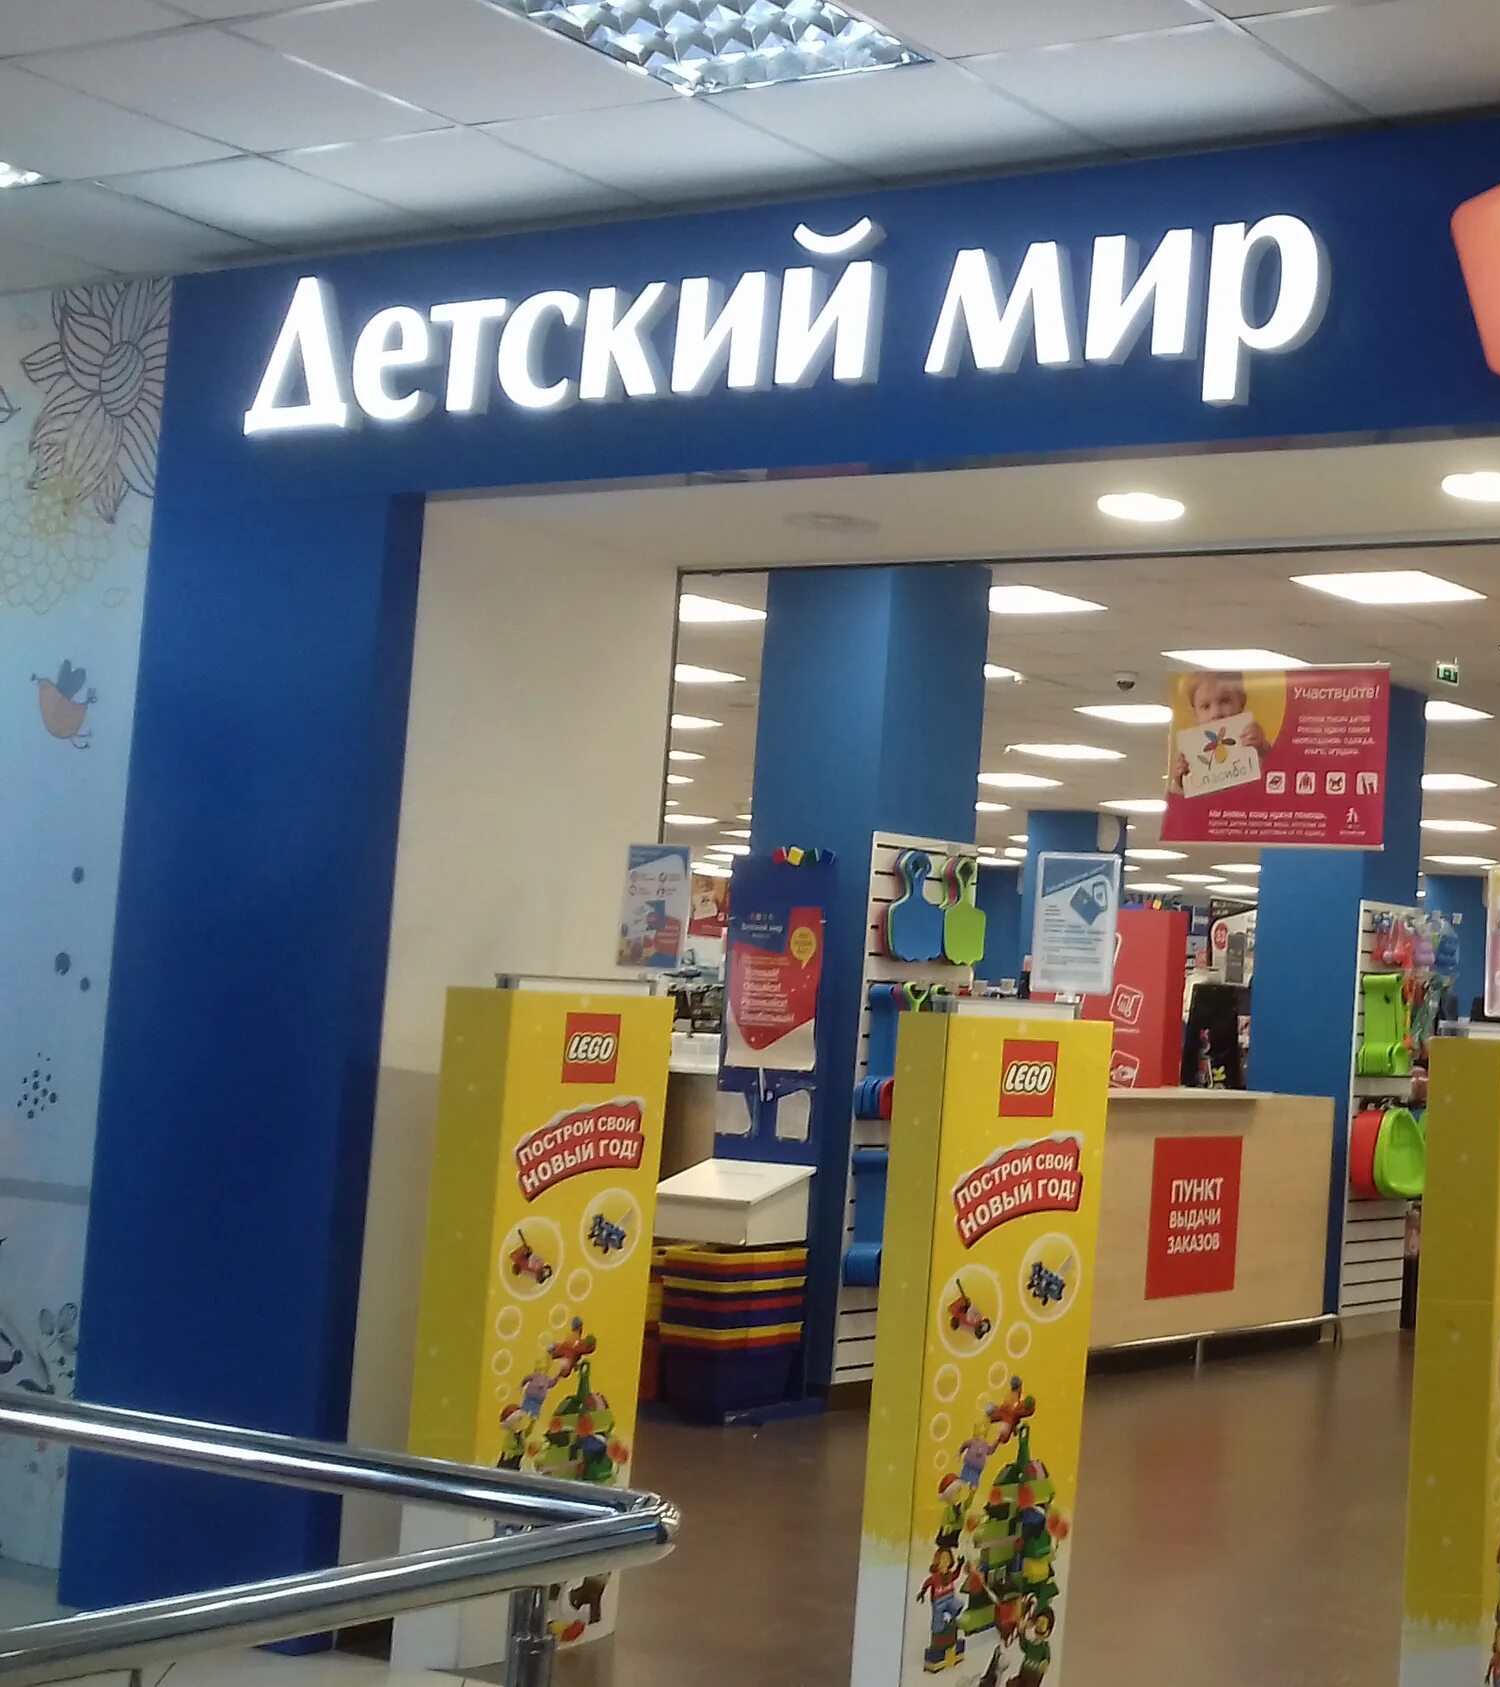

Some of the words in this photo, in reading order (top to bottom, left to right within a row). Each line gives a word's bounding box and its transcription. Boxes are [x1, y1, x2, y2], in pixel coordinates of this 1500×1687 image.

[244, 214, 882, 436] Детский
[924, 212, 1328, 404] мир
[1293, 685, 1380, 702] Участвуйте!
[567, 1033, 616, 1062] LEGO
[1003, 1062, 1054, 1094] LEGO
[518, 1116, 595, 1167] ПОСТРОЙ
[522, 1139, 595, 1194] НОВЫЙ
[599, 1139, 639, 1161] ГОД!
[956, 1152, 1033, 1209] ПОСТРОЙ
[1171, 1177, 1224, 1204] ПУНКТ
[959, 1178, 1033, 1238] НОВЫЙ
[1037, 1178, 1077, 1201] ГОД!
[1169, 1207, 1221, 1231] ВЫДАЧИ
[1167, 1232, 1220, 1255] ЗАКАЗОВ
